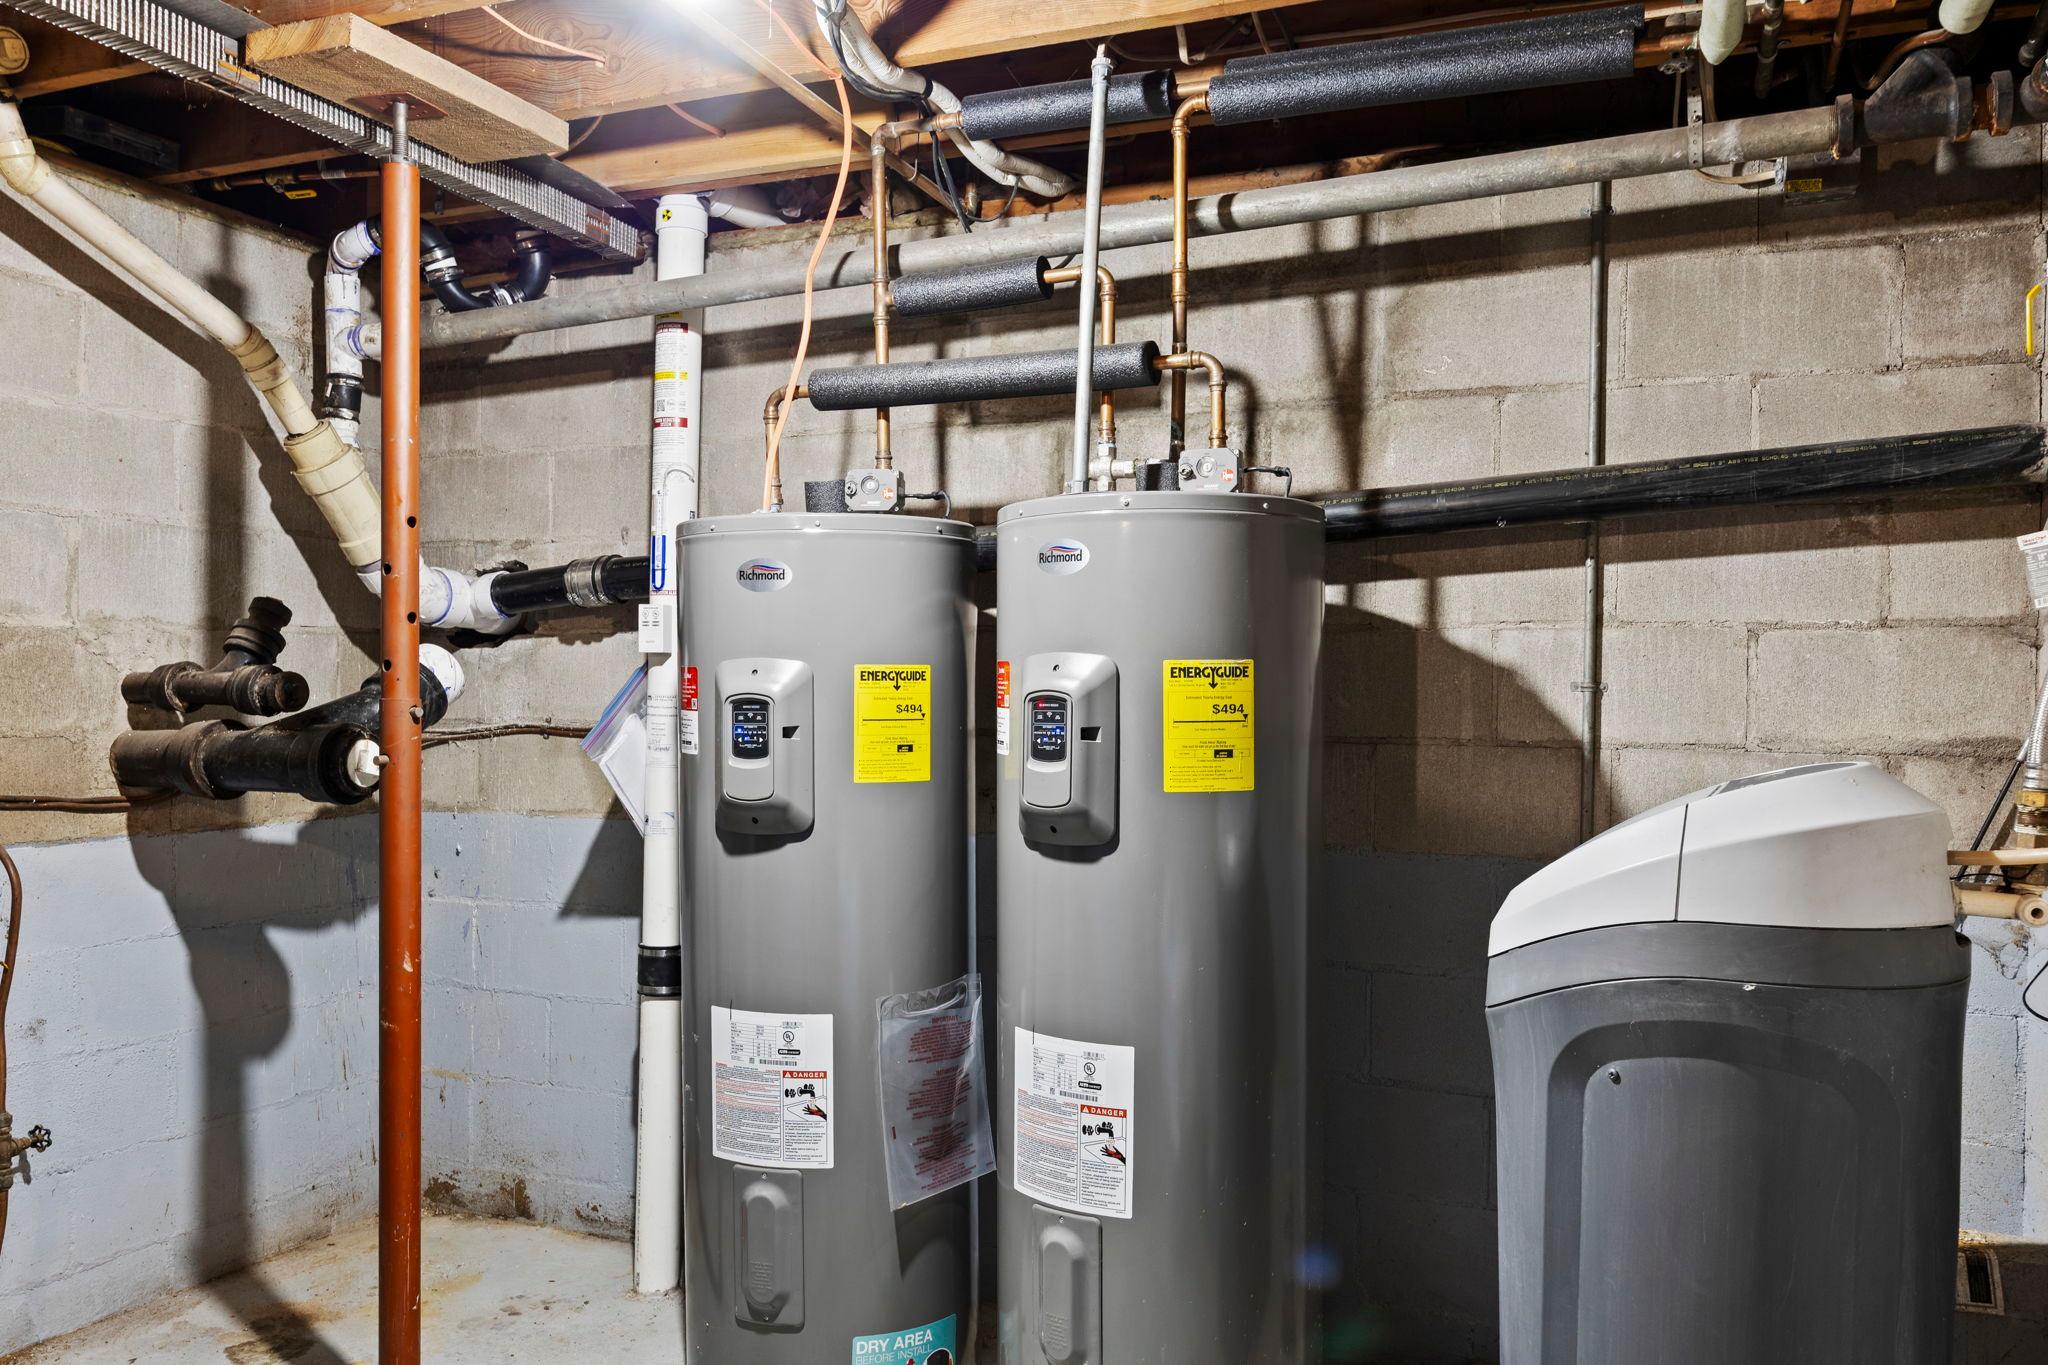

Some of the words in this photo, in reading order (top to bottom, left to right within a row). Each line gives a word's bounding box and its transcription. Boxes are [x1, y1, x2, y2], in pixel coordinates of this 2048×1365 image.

[1039, 549, 1083, 564] Richmond
[739, 569, 785, 582] Richmond
[860, 670, 926, 682] ENERGYGUIDE
[1171, 666, 1249, 678] ENERGYGUIDE
[896, 703, 923, 714] $494
[1212, 703, 1245, 715] $494
[1090, 1107, 1124, 1117] DANGER
[857, 1339, 889, 1354] DRY
[894, 1329, 932, 1350] AREA
[856, 1353, 894, 1365] BEFORE
[898, 1344, 931, 1359] INSTALL
